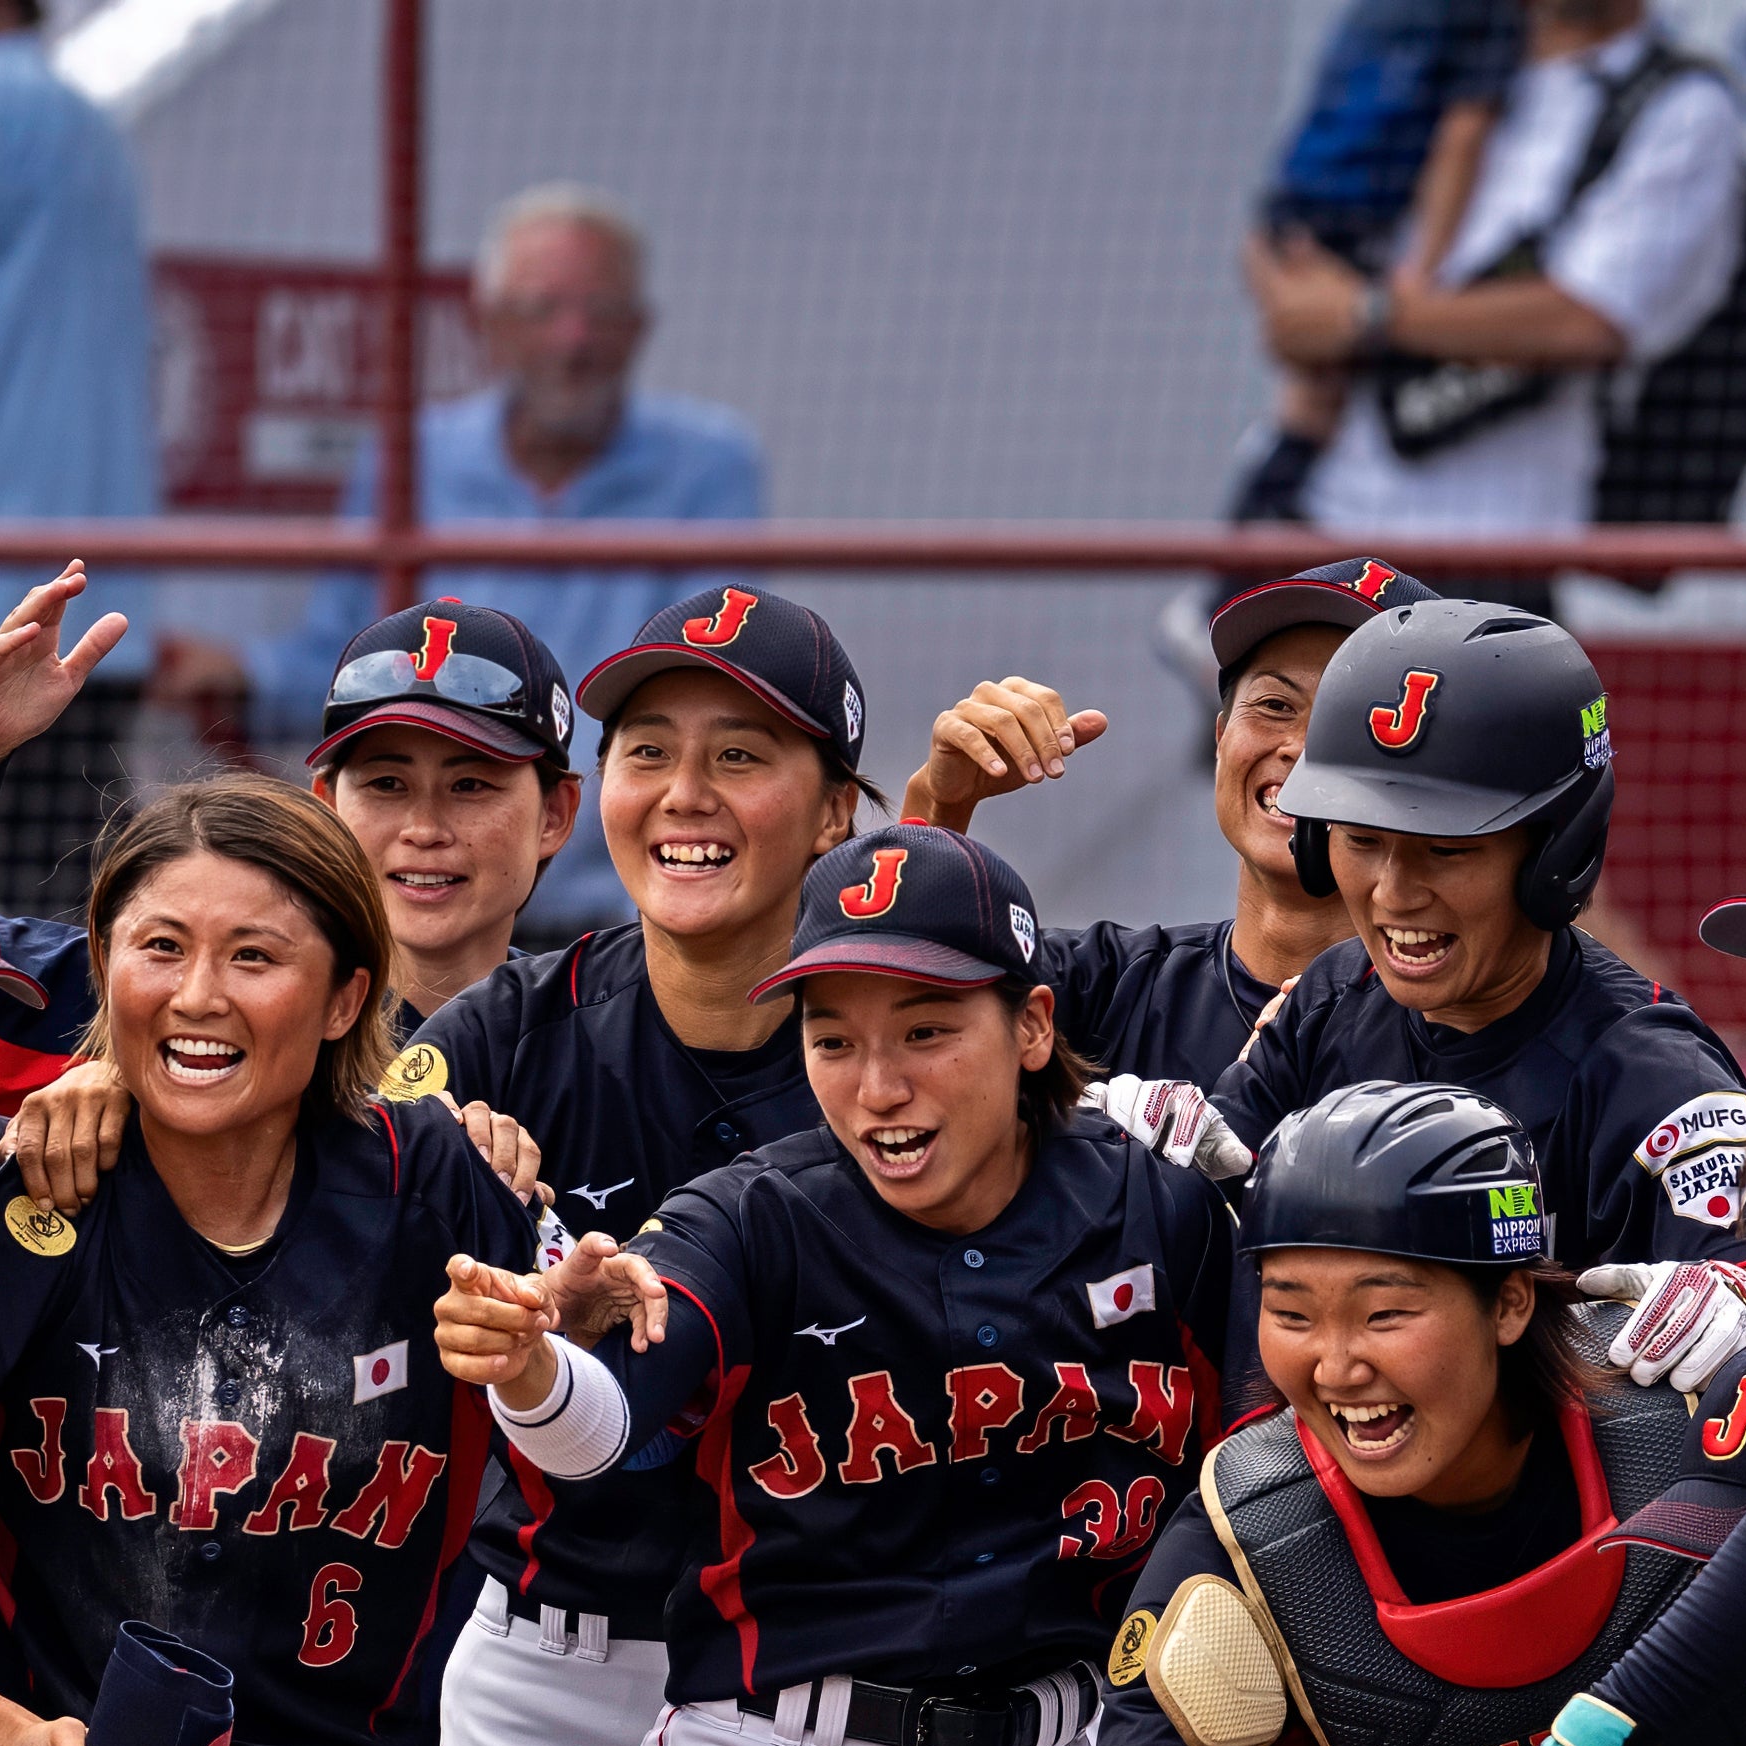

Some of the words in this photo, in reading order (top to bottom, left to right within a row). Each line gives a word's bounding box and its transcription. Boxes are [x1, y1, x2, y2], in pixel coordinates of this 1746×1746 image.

[681, 588, 759, 647] J
[1367, 666, 1440, 756] J
[838, 848, 909, 919] J
[1680, 1108, 1746, 1134] MUFG
[1488, 1186, 1538, 1219] NX
[1492, 1218, 1542, 1238] NIPPON
[1494, 1236, 1541, 1254] EXPRESS
[748, 1361, 1196, 1500] JAPAN
[10, 1396, 448, 1550] JAPAN
[1057, 1476, 1165, 1561] 30
[298, 1562, 363, 1667] 6
